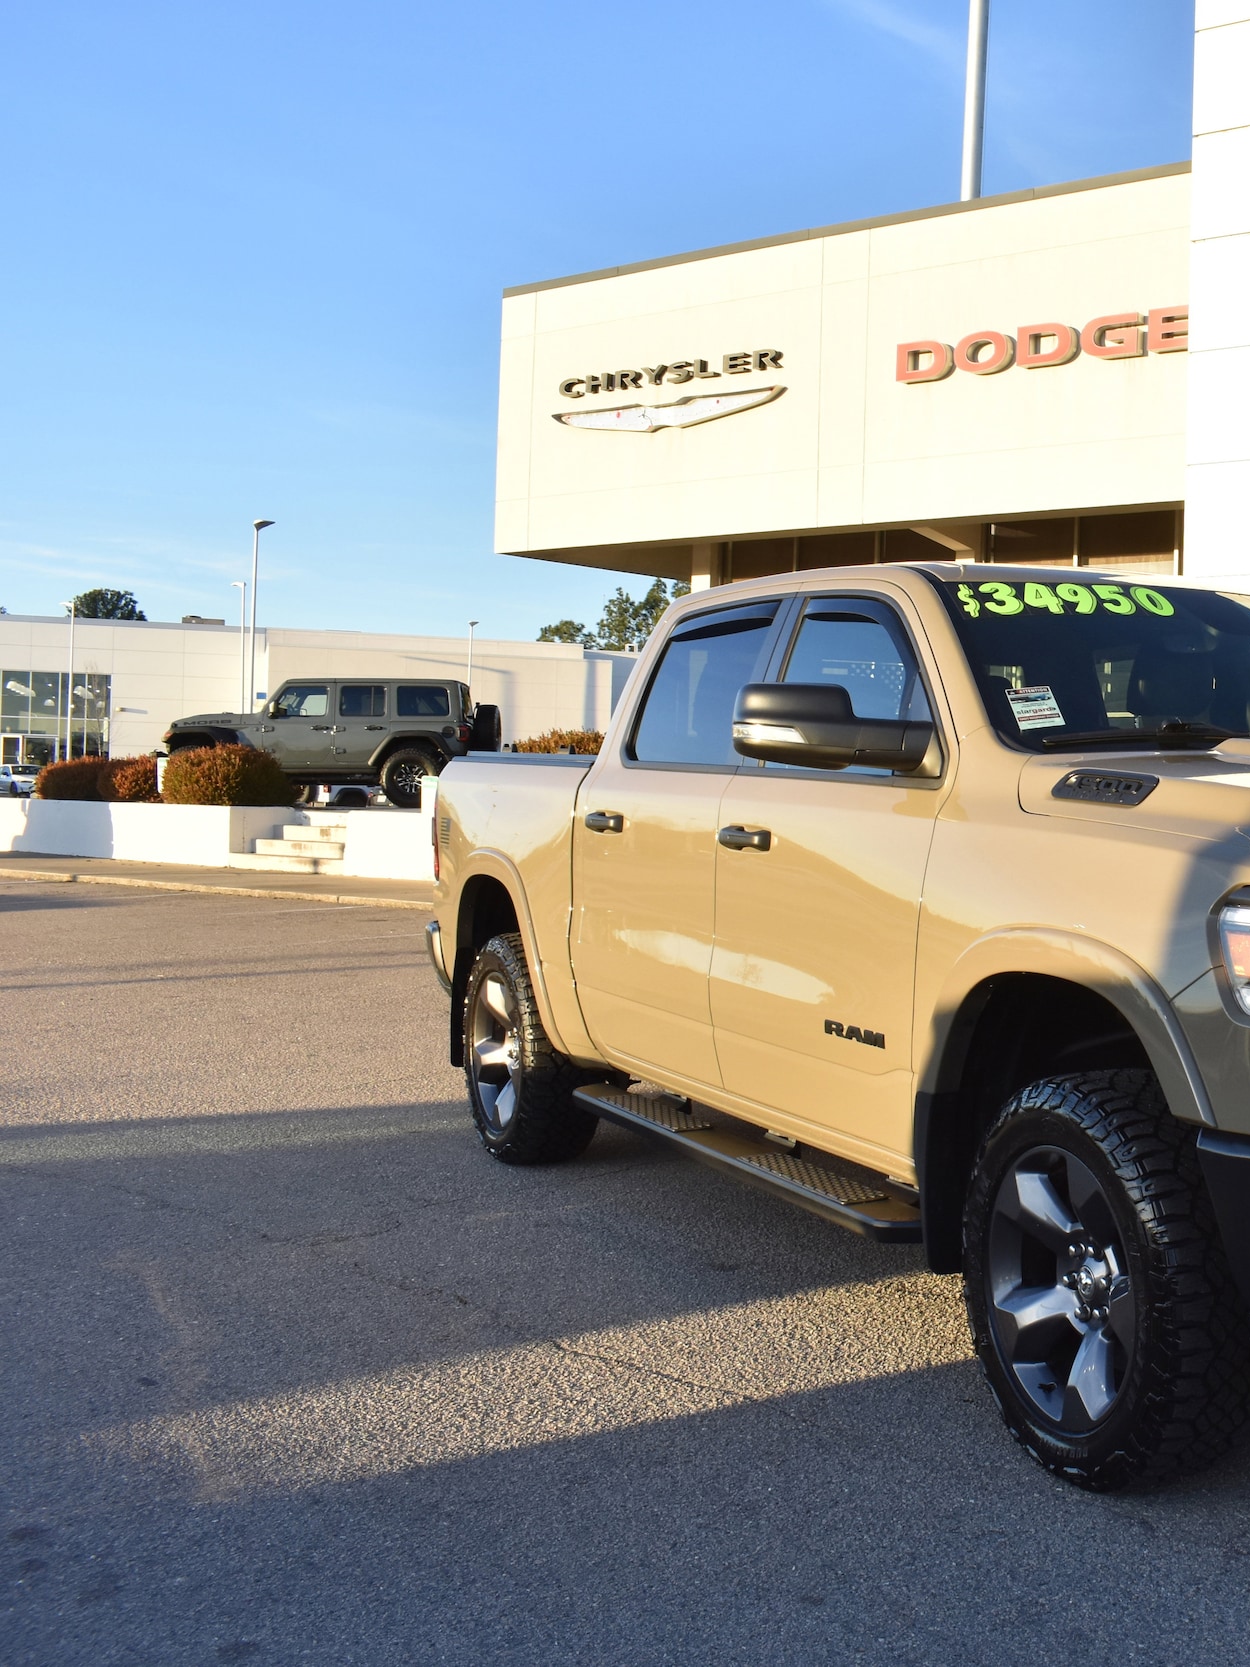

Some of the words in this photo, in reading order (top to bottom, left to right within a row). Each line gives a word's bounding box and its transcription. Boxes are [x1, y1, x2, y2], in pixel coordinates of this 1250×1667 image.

[896, 304, 1190, 385] DODGE
[558, 348, 784, 398] CHRYSLER
[956, 581, 1176, 618] $34950
[824, 1019, 886, 1049] RAM
